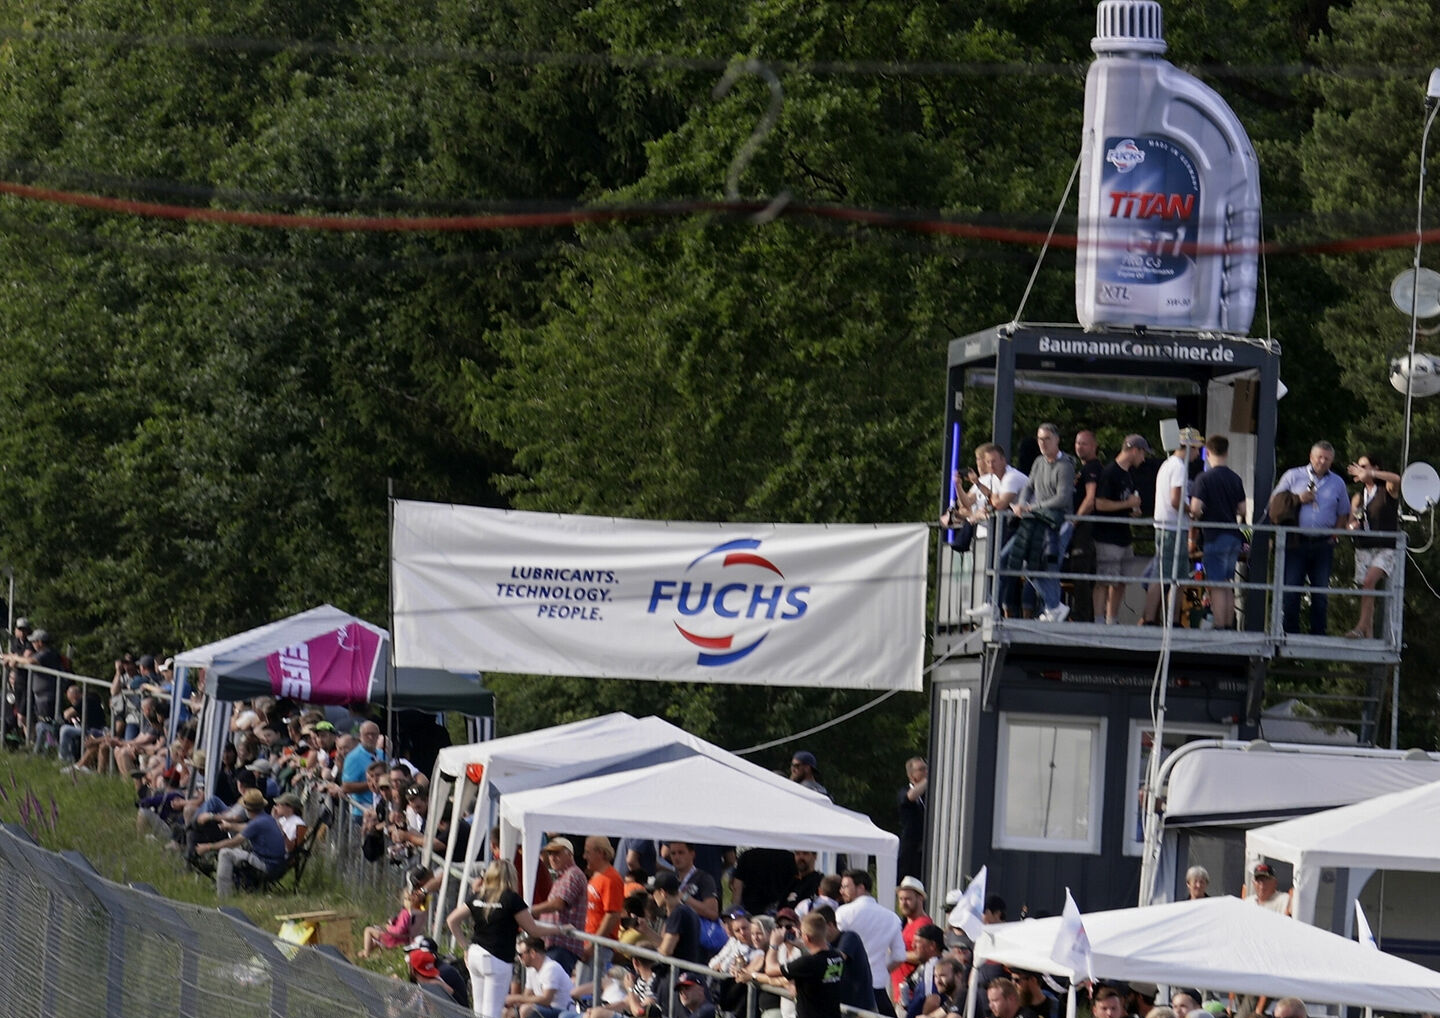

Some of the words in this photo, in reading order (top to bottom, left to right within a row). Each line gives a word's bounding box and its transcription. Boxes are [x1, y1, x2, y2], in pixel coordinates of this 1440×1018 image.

[1109, 191, 1195, 221] TITAN
[1039, 336, 1235, 363] BaumannContainer.de
[511, 566, 620, 584] LUBRICANTS.
[496, 583, 613, 602] TECHNOLOGY.
[647, 580, 812, 621] FUCHS
[537, 604, 604, 621] PEOPLE.
